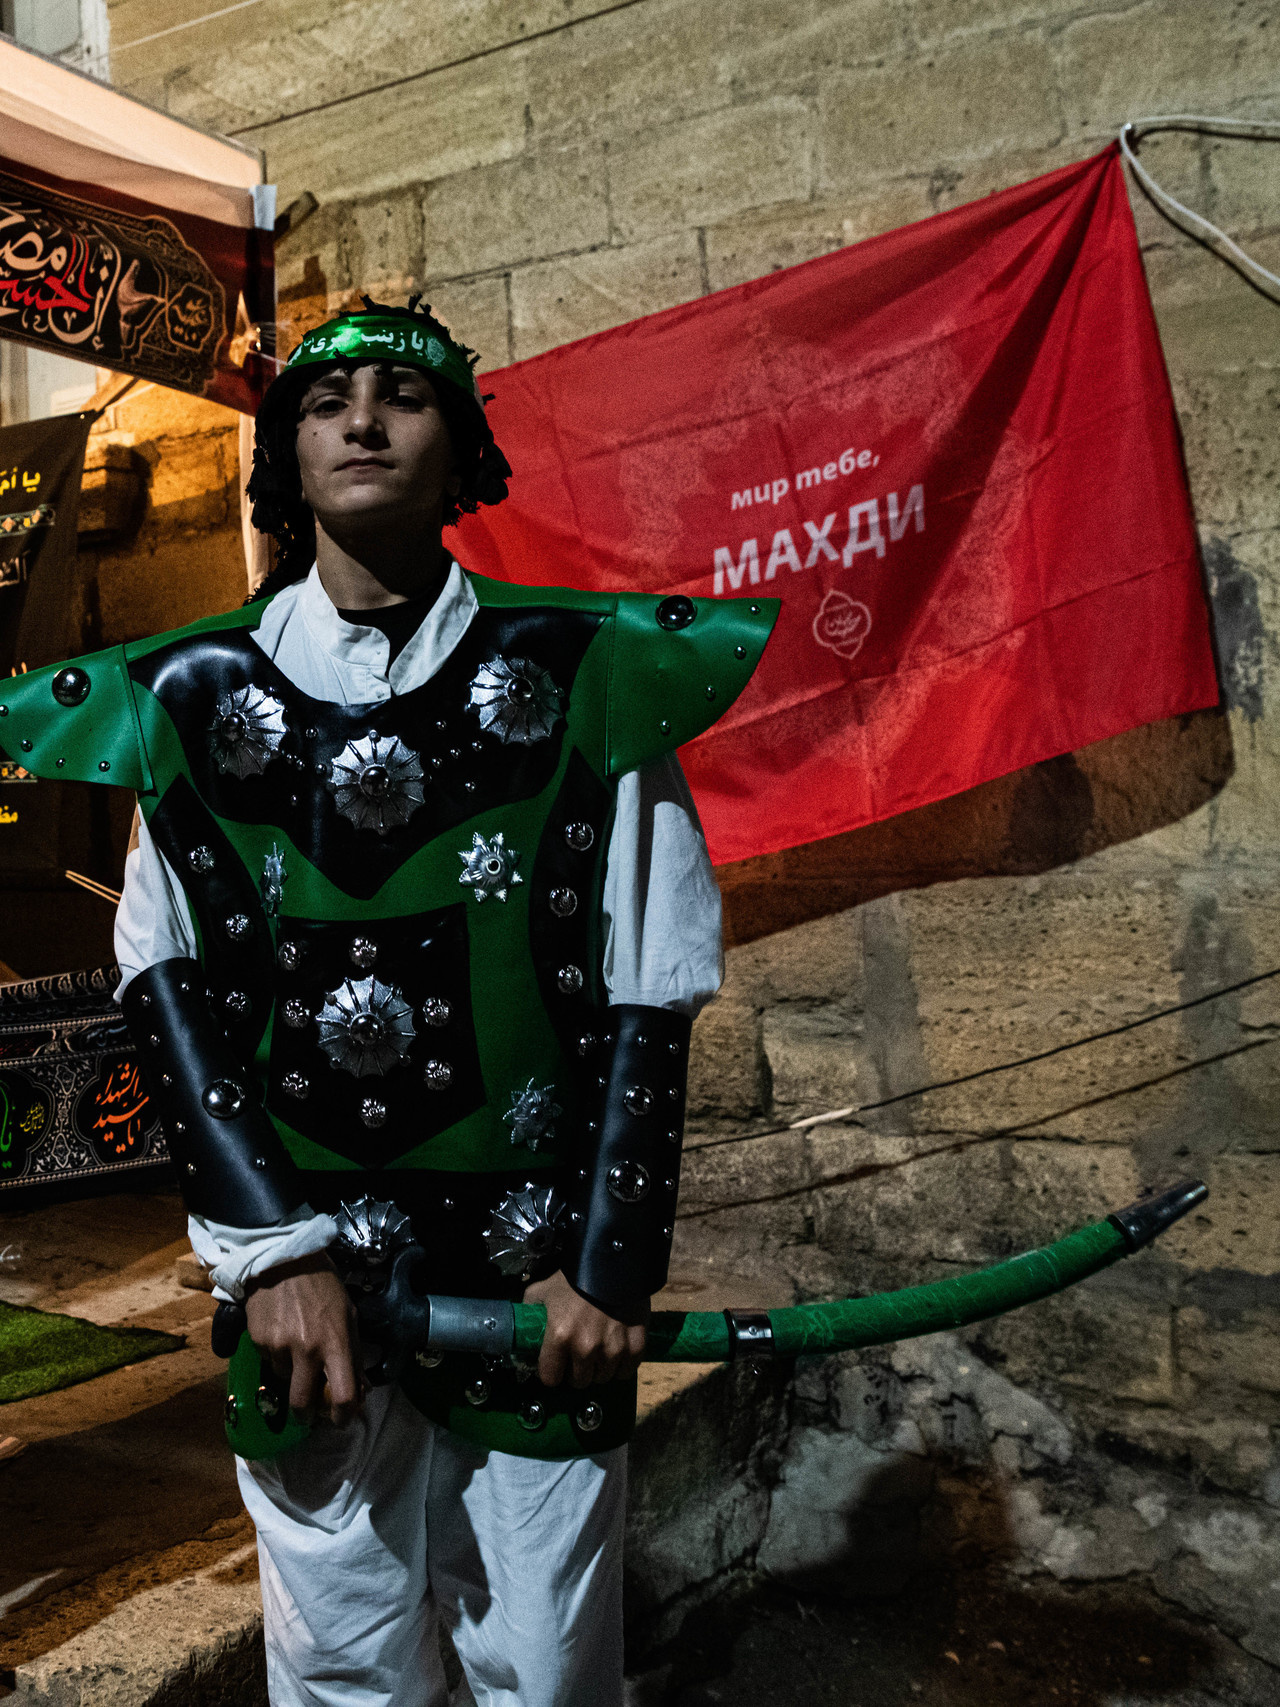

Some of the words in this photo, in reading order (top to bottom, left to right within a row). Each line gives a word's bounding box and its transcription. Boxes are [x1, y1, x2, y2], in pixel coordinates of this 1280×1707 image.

[22, 470, 42, 493] يا
[730, 480, 789, 512] мир
[795, 447, 881, 492] тебе,
[712, 482, 926, 596] МАХДИ
